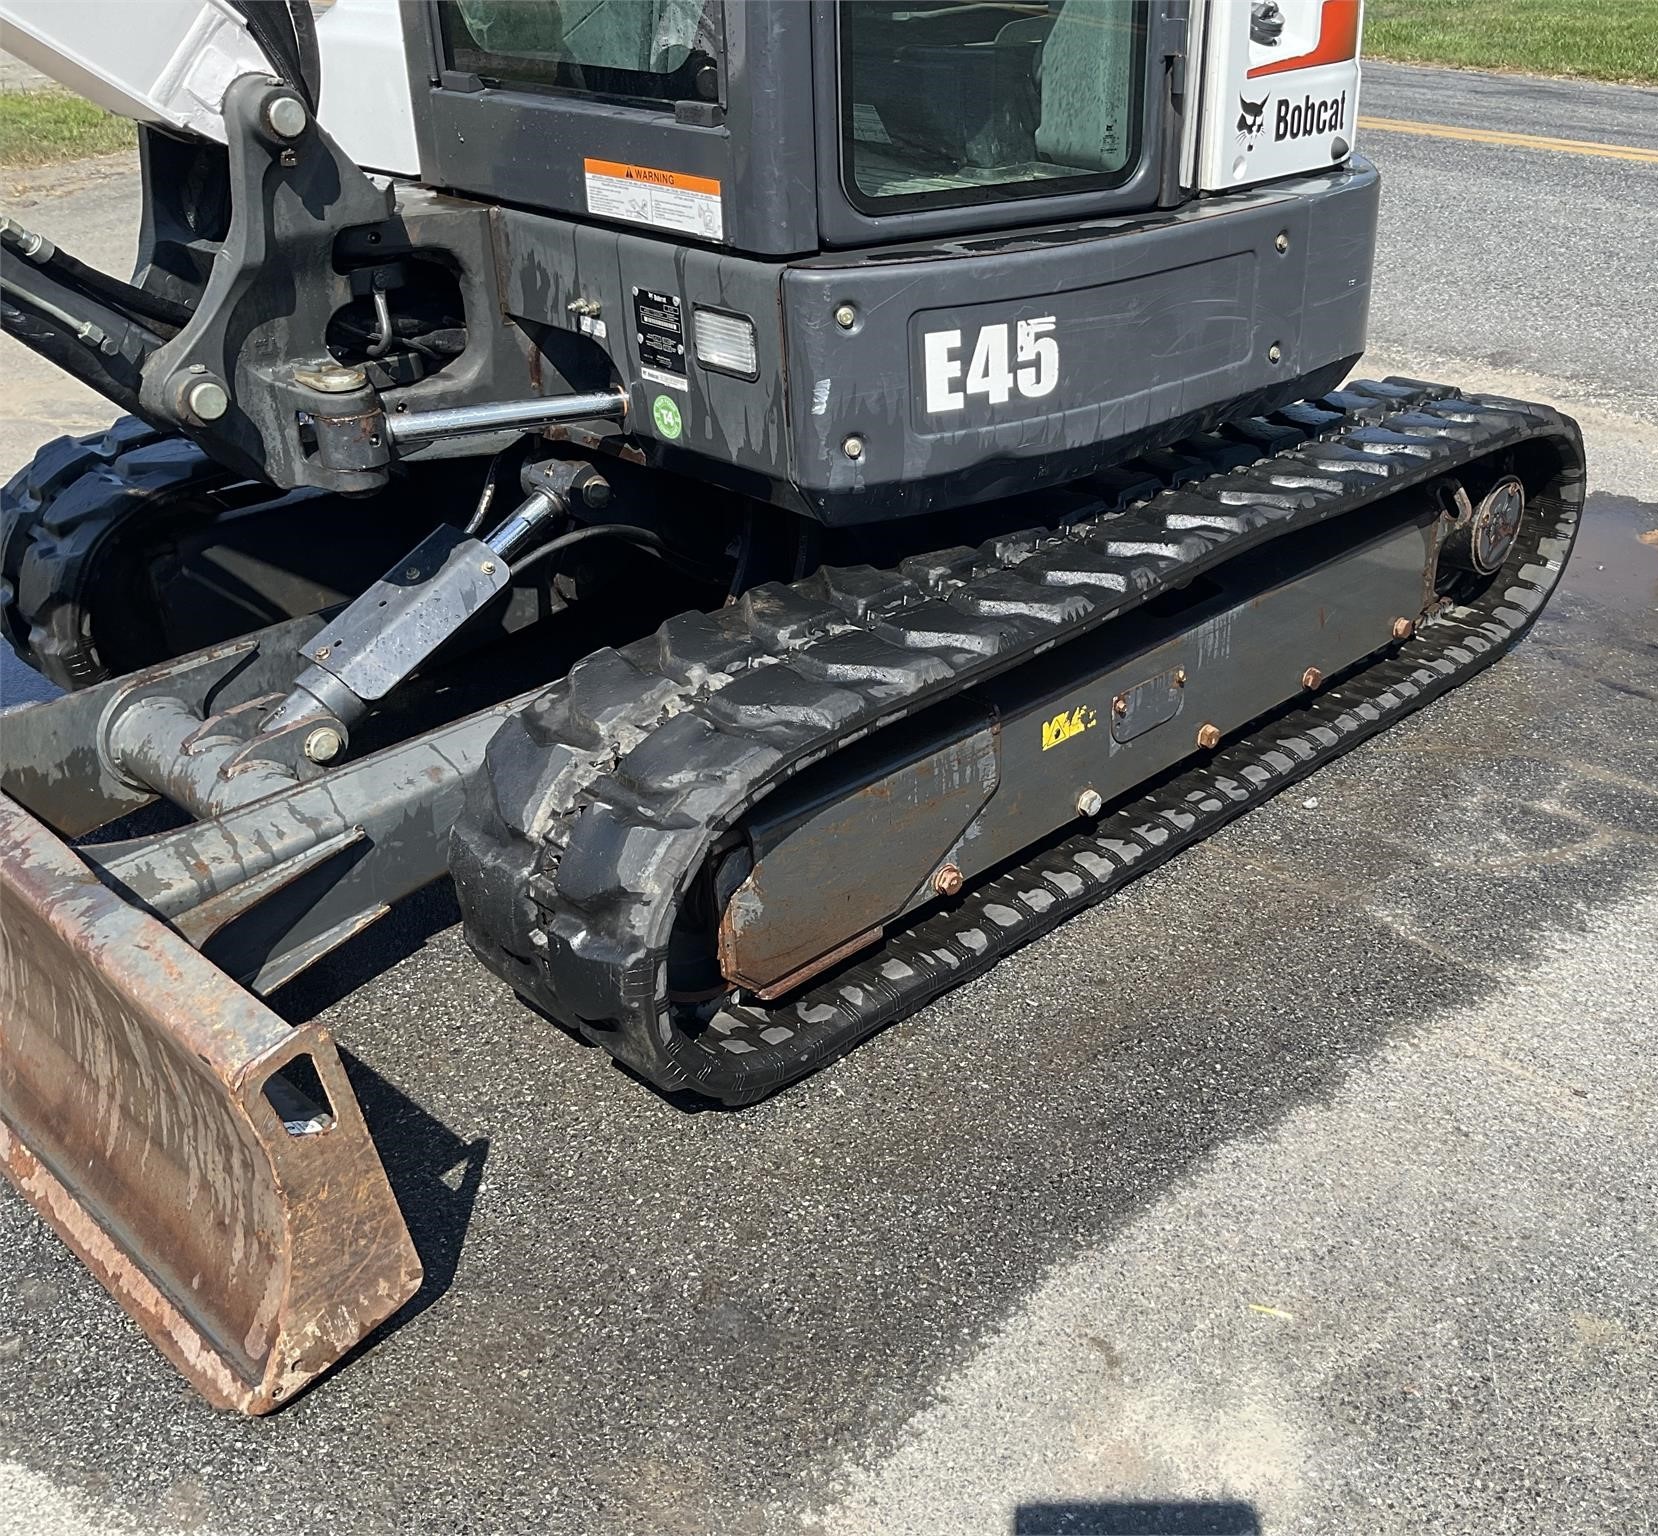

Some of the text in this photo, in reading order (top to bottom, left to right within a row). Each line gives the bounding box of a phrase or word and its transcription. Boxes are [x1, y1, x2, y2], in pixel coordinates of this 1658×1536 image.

[1274, 90, 1345, 142] Bobcat
[634, 169, 675, 185] WARNING
[925, 316, 1058, 413] E45
